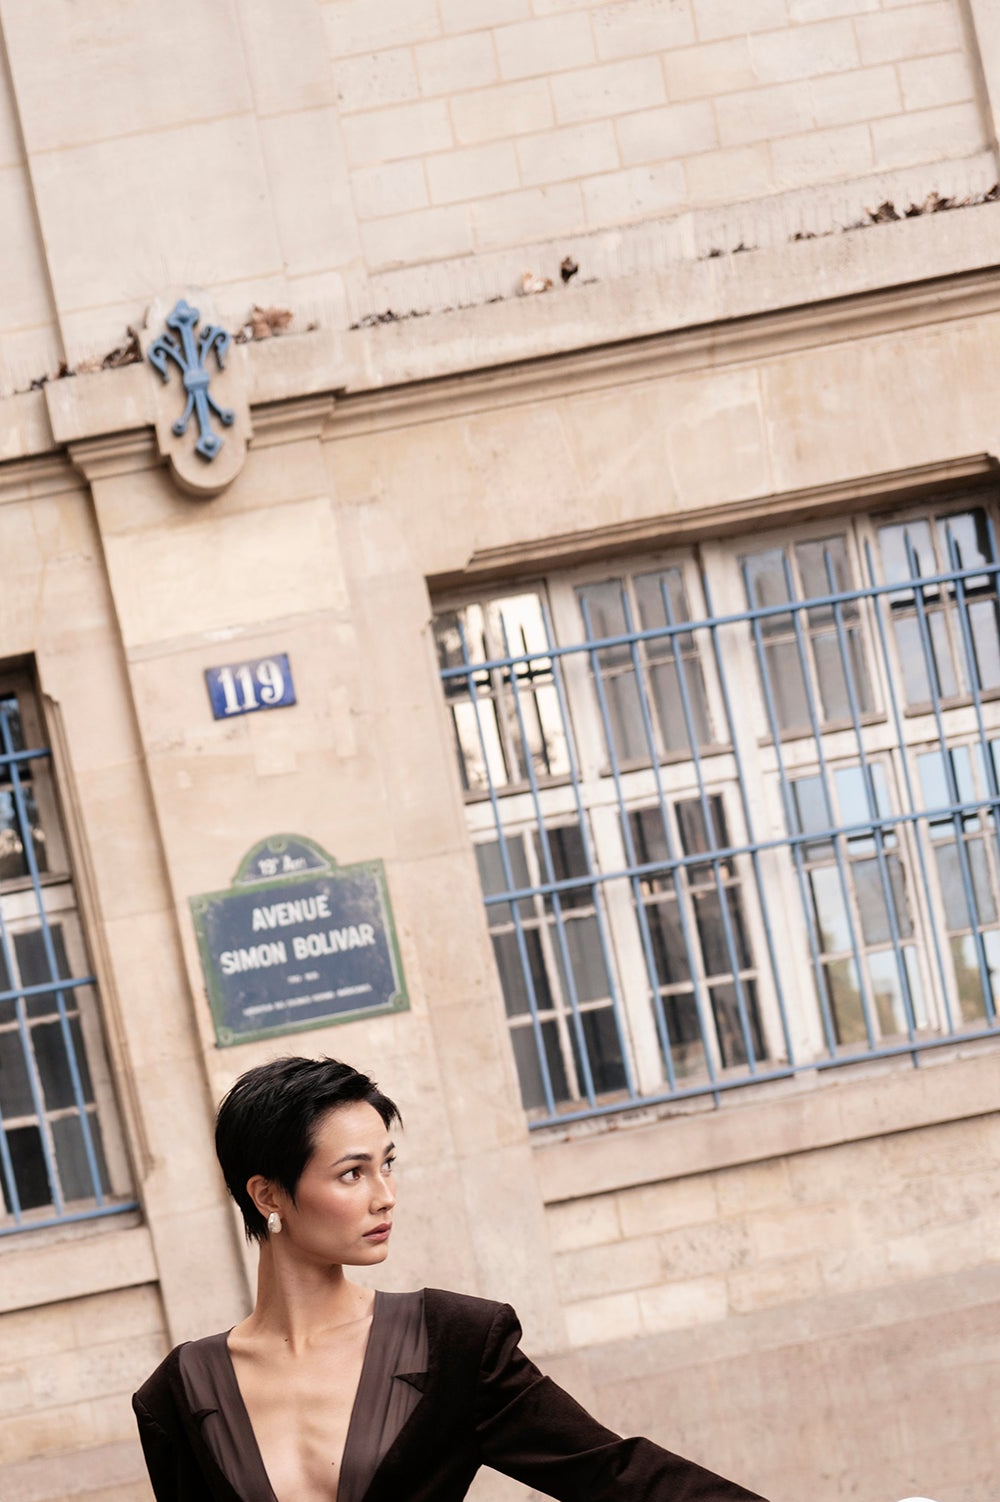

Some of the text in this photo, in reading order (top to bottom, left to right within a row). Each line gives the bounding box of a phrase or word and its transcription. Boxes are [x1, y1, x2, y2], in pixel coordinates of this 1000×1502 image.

[217, 659, 284, 714] 119
[251, 895, 332, 931] AVENUE
[220, 923, 376, 975] SIMON BOLIVAR
